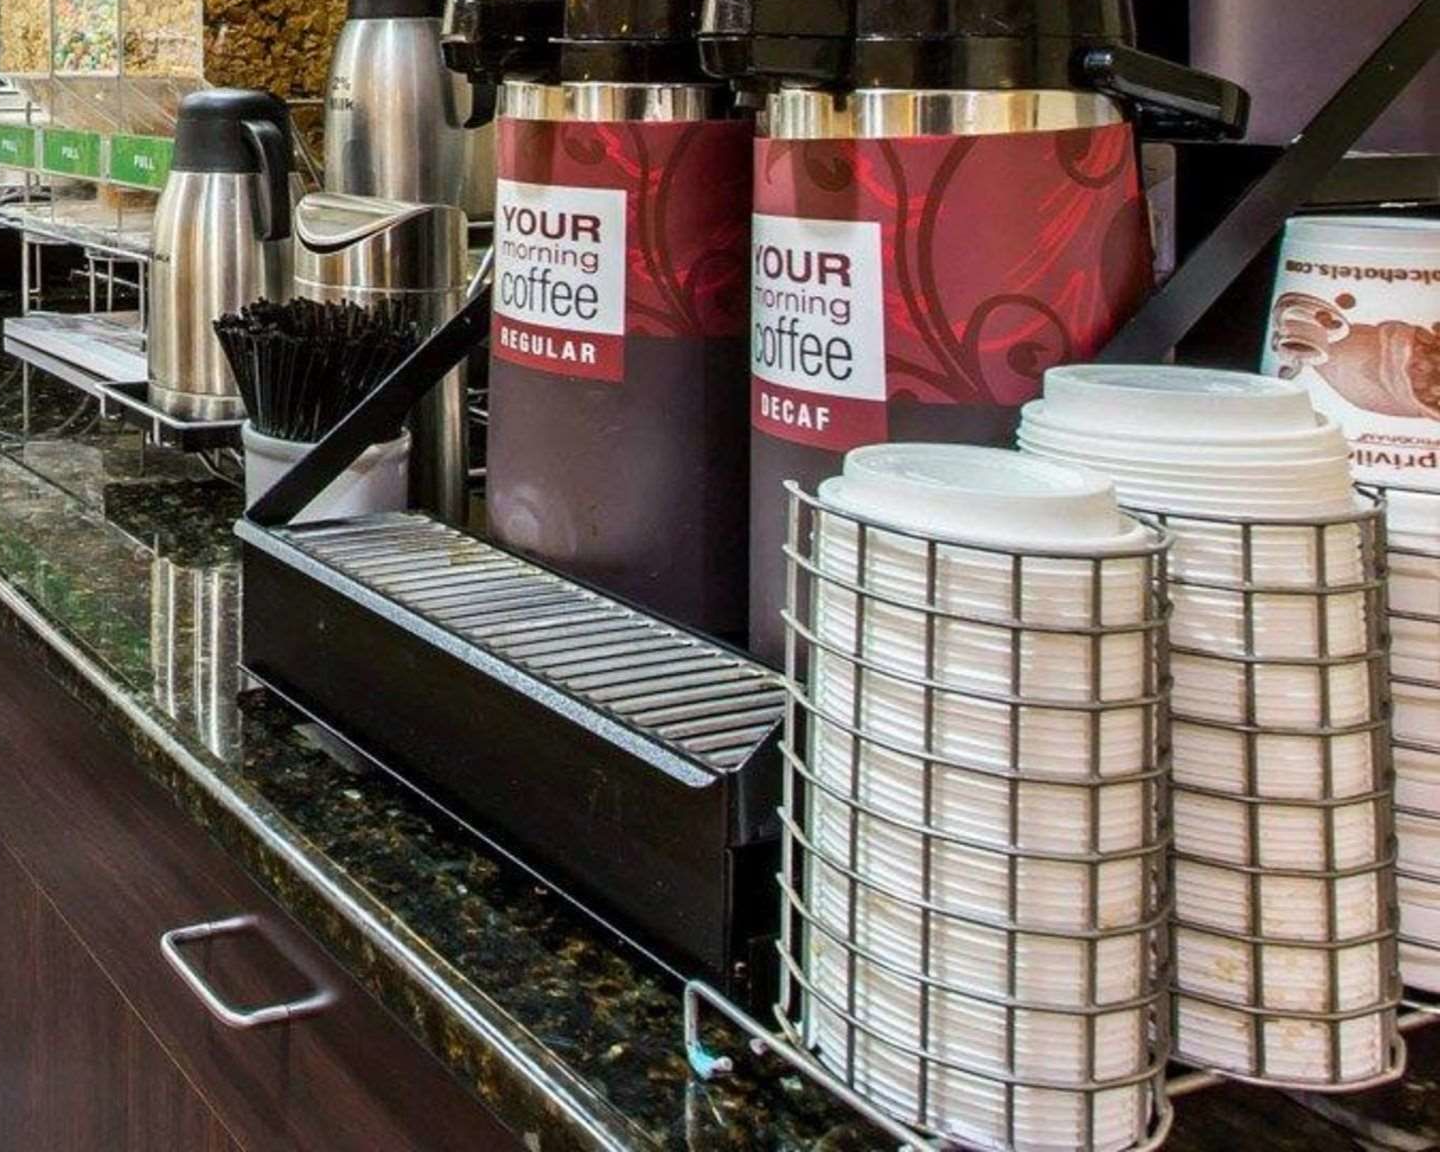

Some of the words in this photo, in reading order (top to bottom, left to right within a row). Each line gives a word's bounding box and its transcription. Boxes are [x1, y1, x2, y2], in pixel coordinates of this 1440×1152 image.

[133, 153, 155, 171] PULL
[503, 205, 602, 243] YOUR
[503, 240, 599, 274] morning
[501, 266, 599, 321] coffee
[500, 326, 596, 364] REGULAR
[760, 391, 830, 431] DECAF
[1348, 449, 1436, 469] privil
